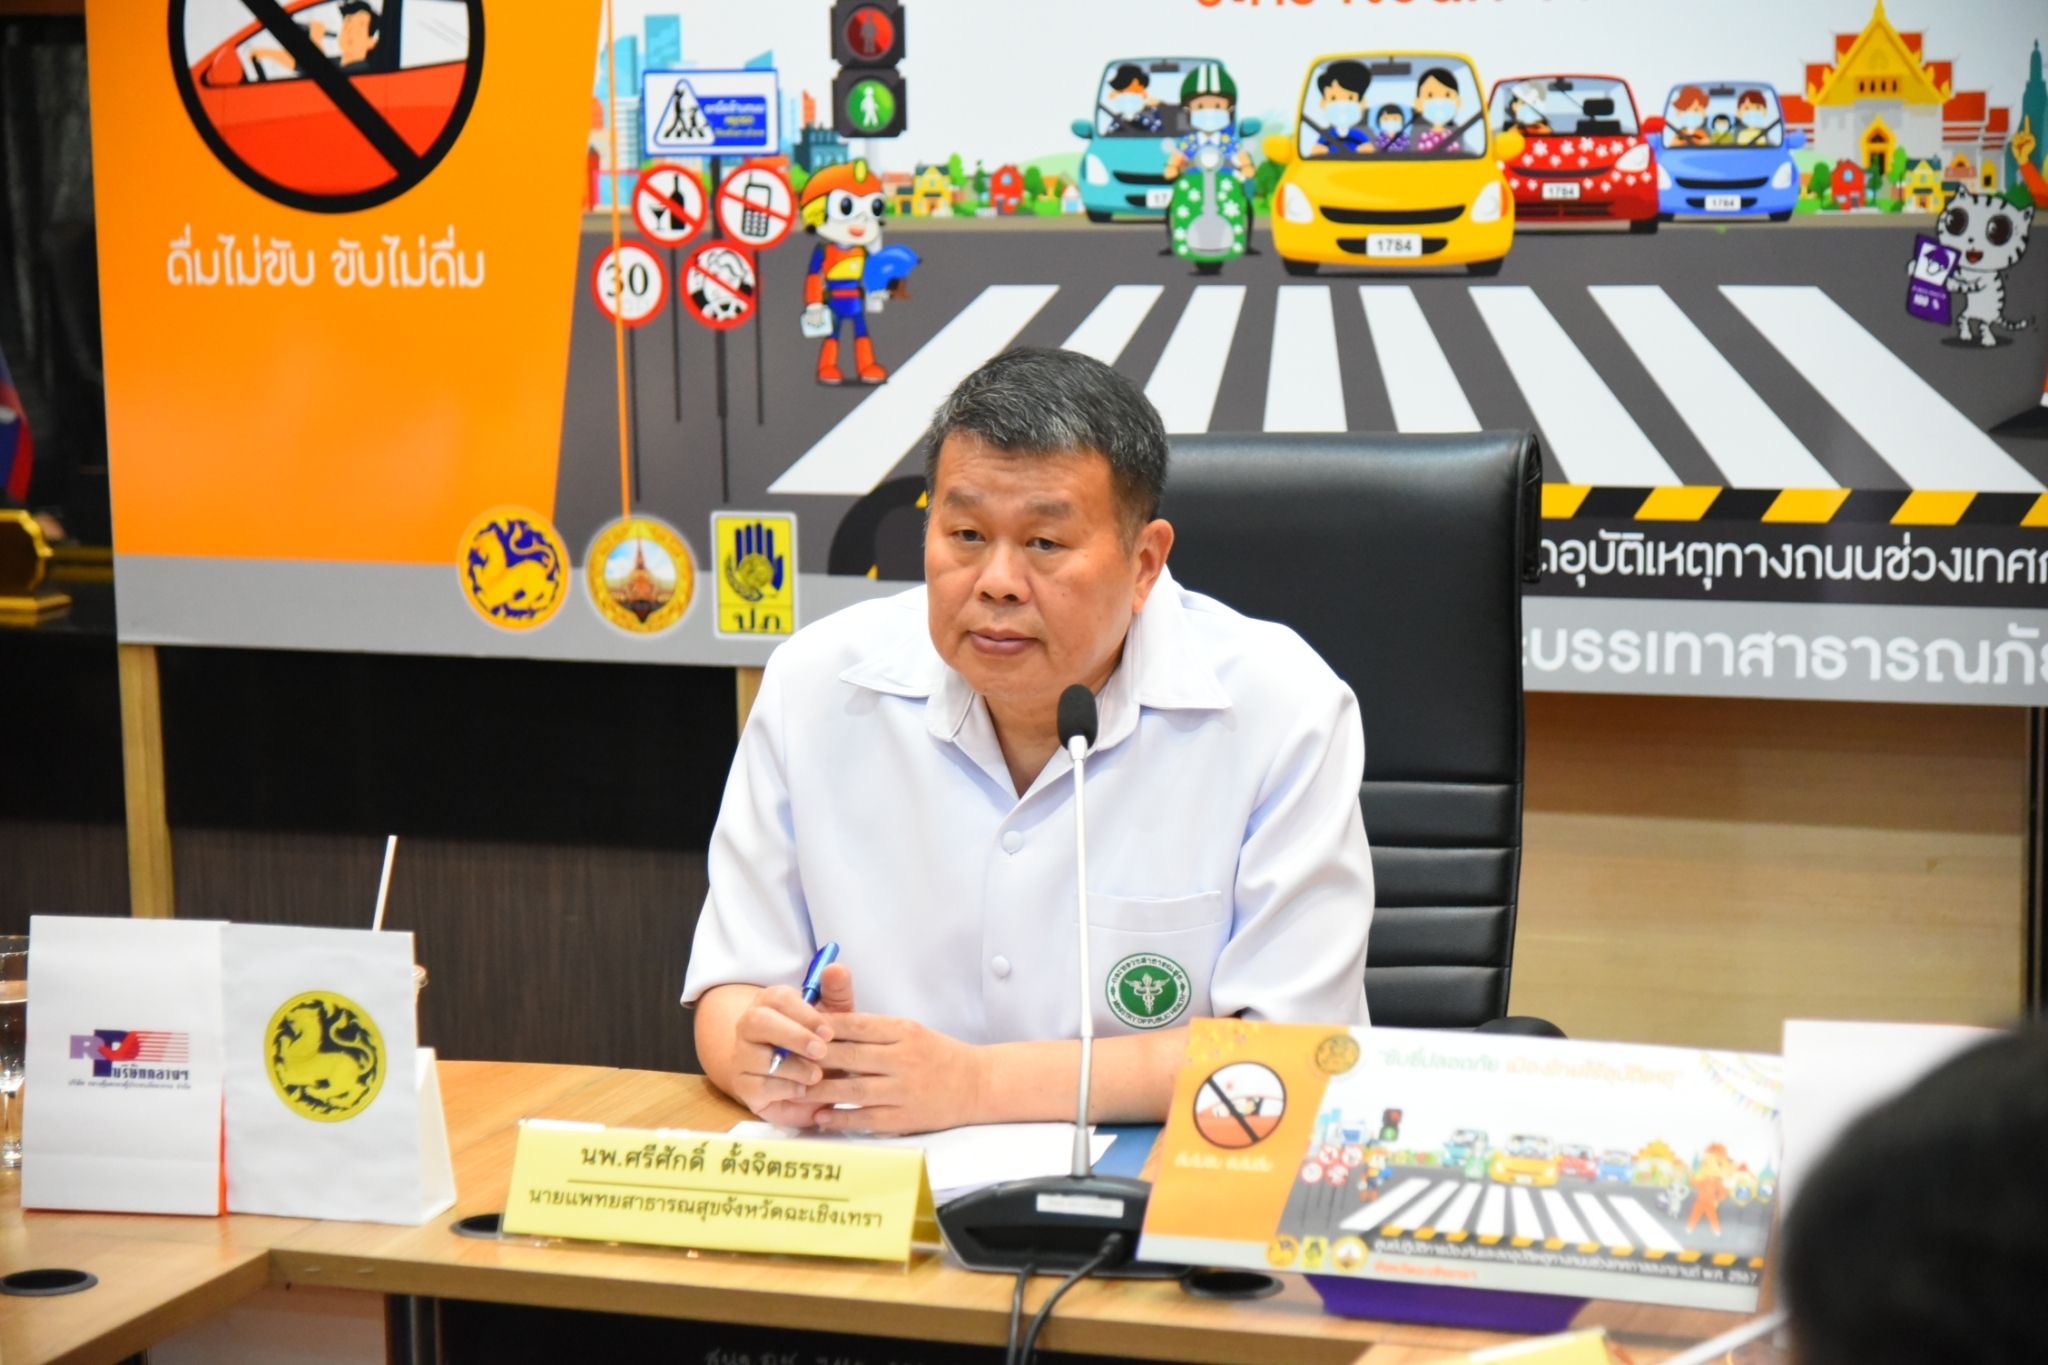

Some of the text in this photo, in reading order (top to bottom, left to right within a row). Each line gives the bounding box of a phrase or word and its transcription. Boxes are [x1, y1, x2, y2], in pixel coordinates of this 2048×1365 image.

[167, 223, 485, 288] ดื่มไม่ขับ ขับไม่ดื่ม
[1377, 239, 1412, 252] 1784
[605, 262, 649, 297] 30
[1522, 621, 2048, 688] บรรเทาสาธารณภั
[581, 1141, 842, 1182] นพ.ศรีศักดิ์ ตั้งจิตธรรม
